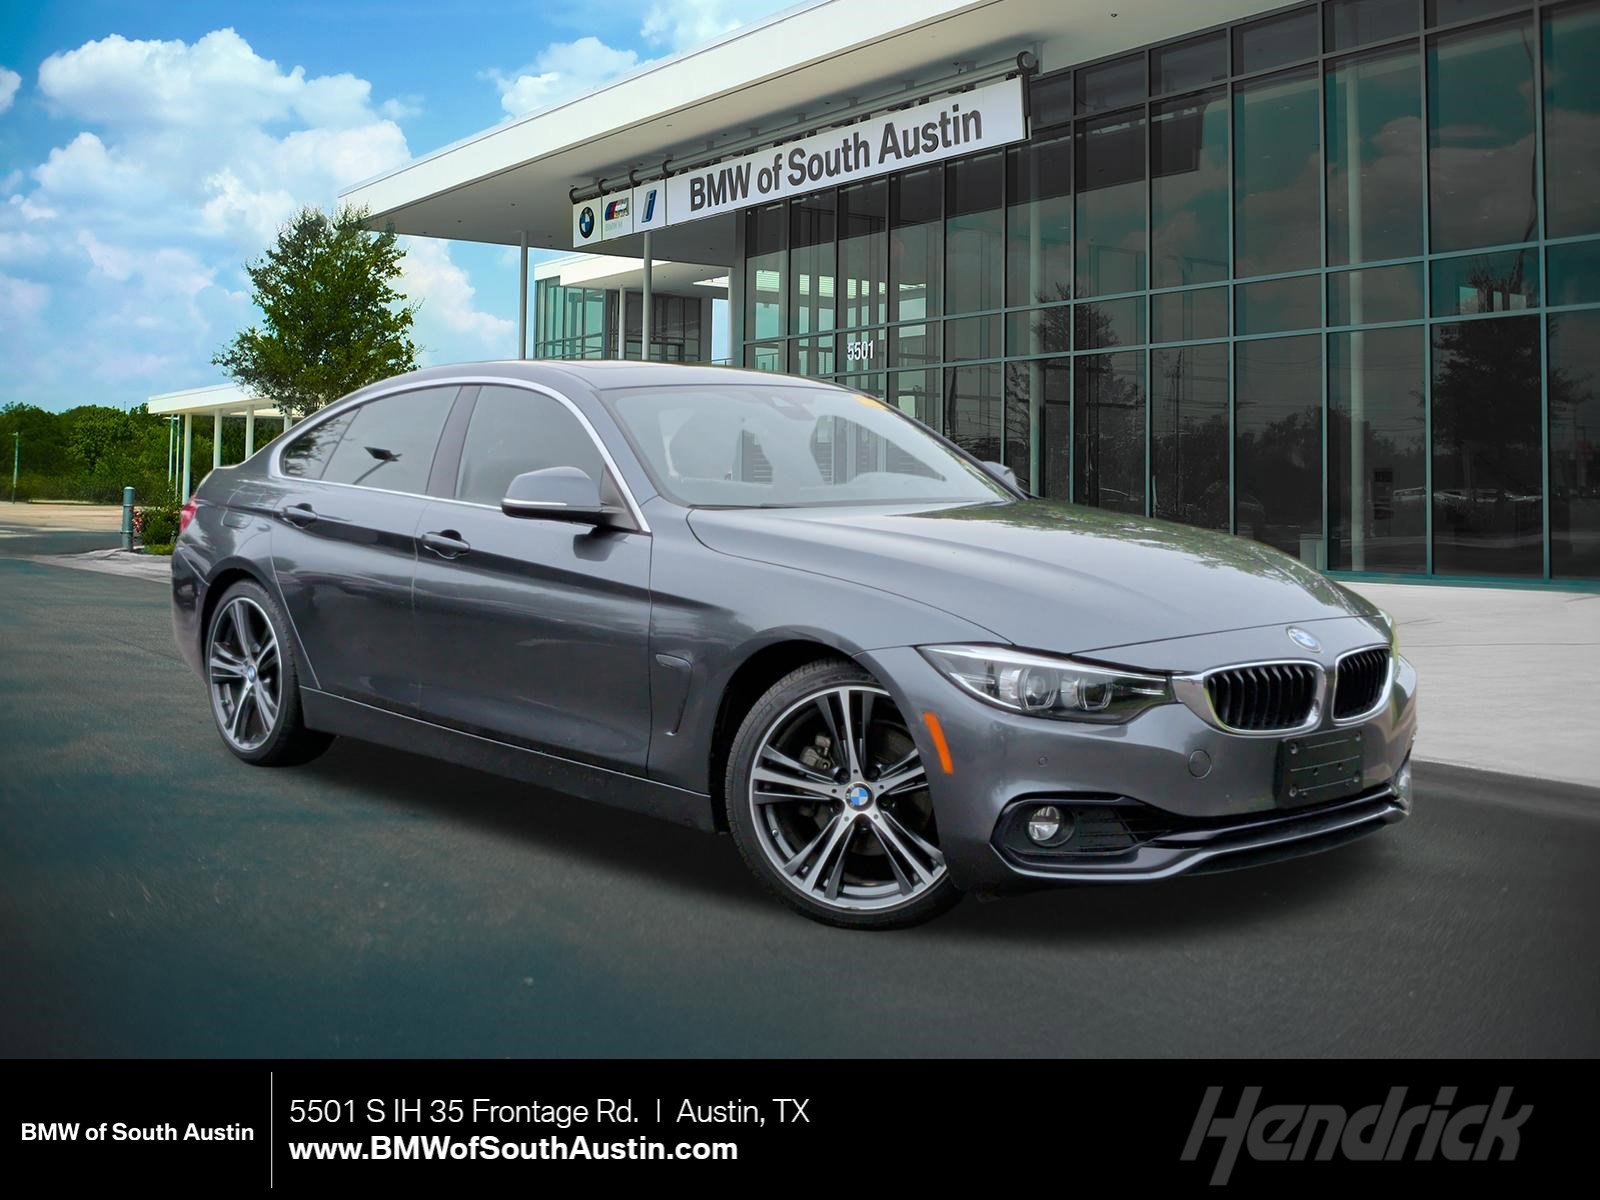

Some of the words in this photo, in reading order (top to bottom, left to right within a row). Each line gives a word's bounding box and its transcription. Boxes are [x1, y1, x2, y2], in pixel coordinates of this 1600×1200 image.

[690, 162, 751, 211] BMW
[757, 152, 783, 194] of
[787, 131, 870, 186] South
[878, 103, 983, 164] Austin
[847, 340, 874, 361] 5501
